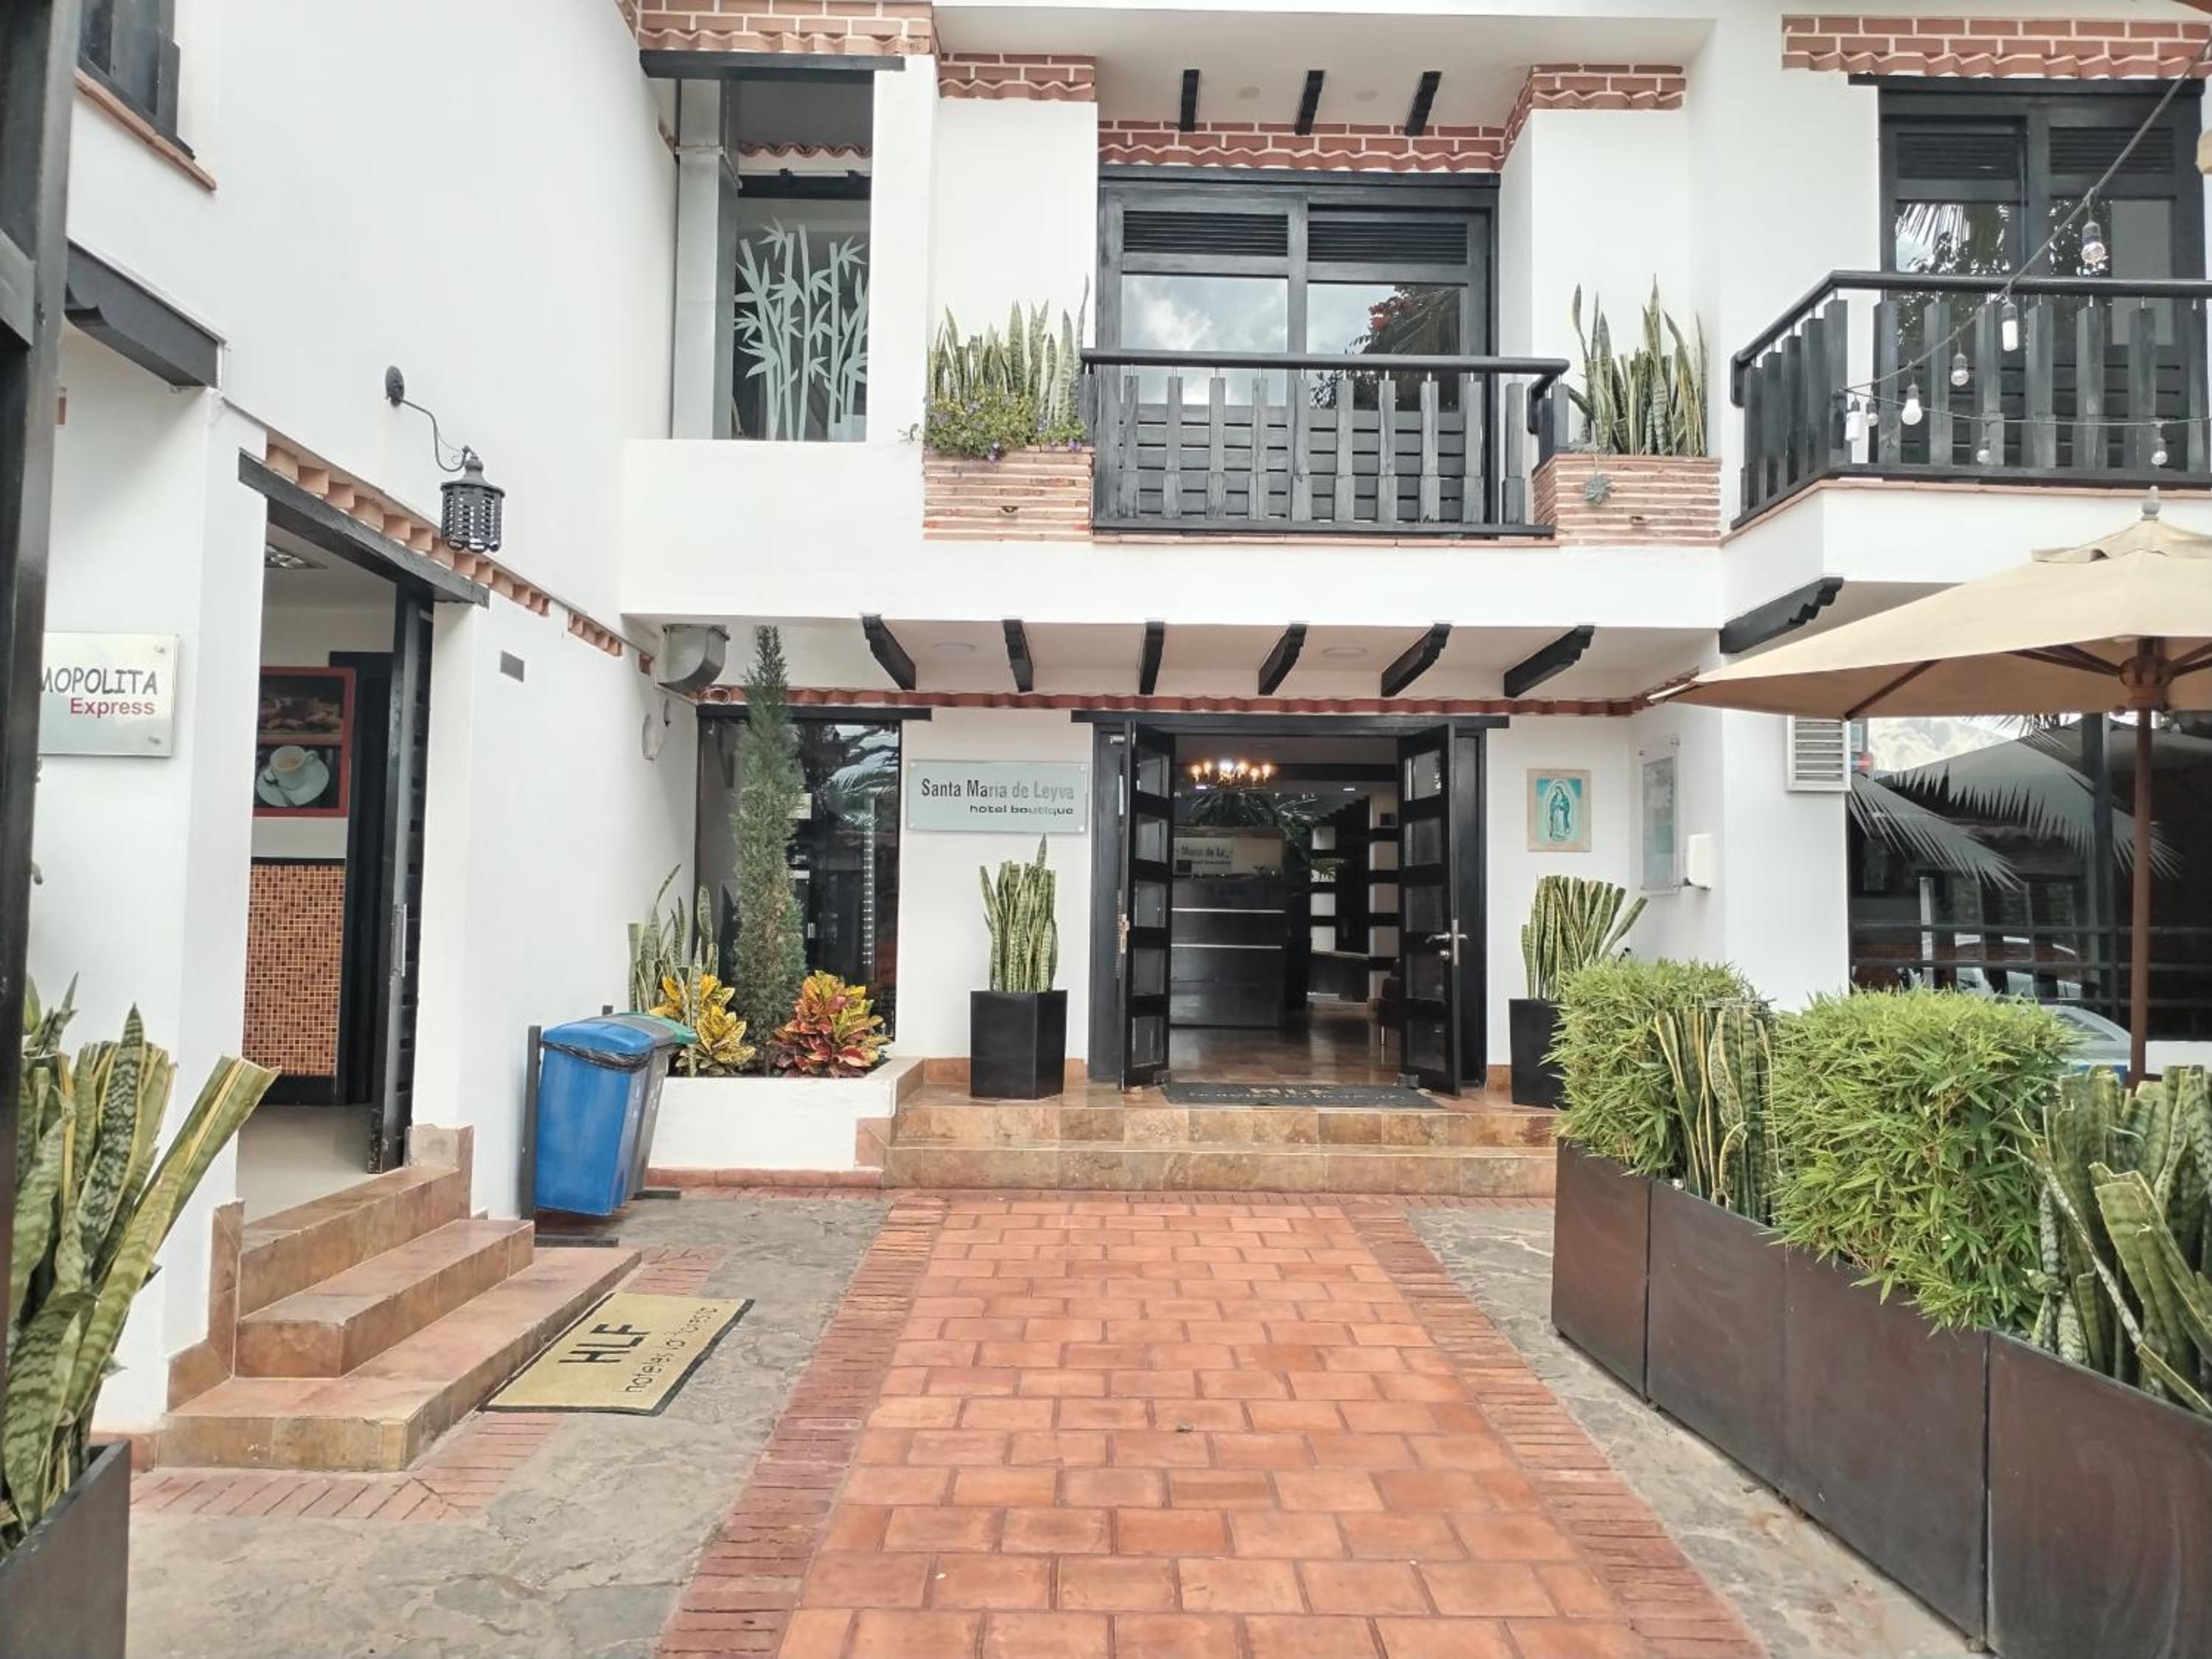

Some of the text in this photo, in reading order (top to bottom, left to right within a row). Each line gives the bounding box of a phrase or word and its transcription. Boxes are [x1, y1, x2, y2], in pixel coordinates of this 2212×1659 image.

[71, 698, 156, 718] Express
[922, 779, 961, 796] Santa
[1012, 781, 1029, 798] de
[1034, 781, 1074, 803] Leyva
[970, 805, 1074, 816] hotel boutique
[558, 1324, 651, 1363] HLF
